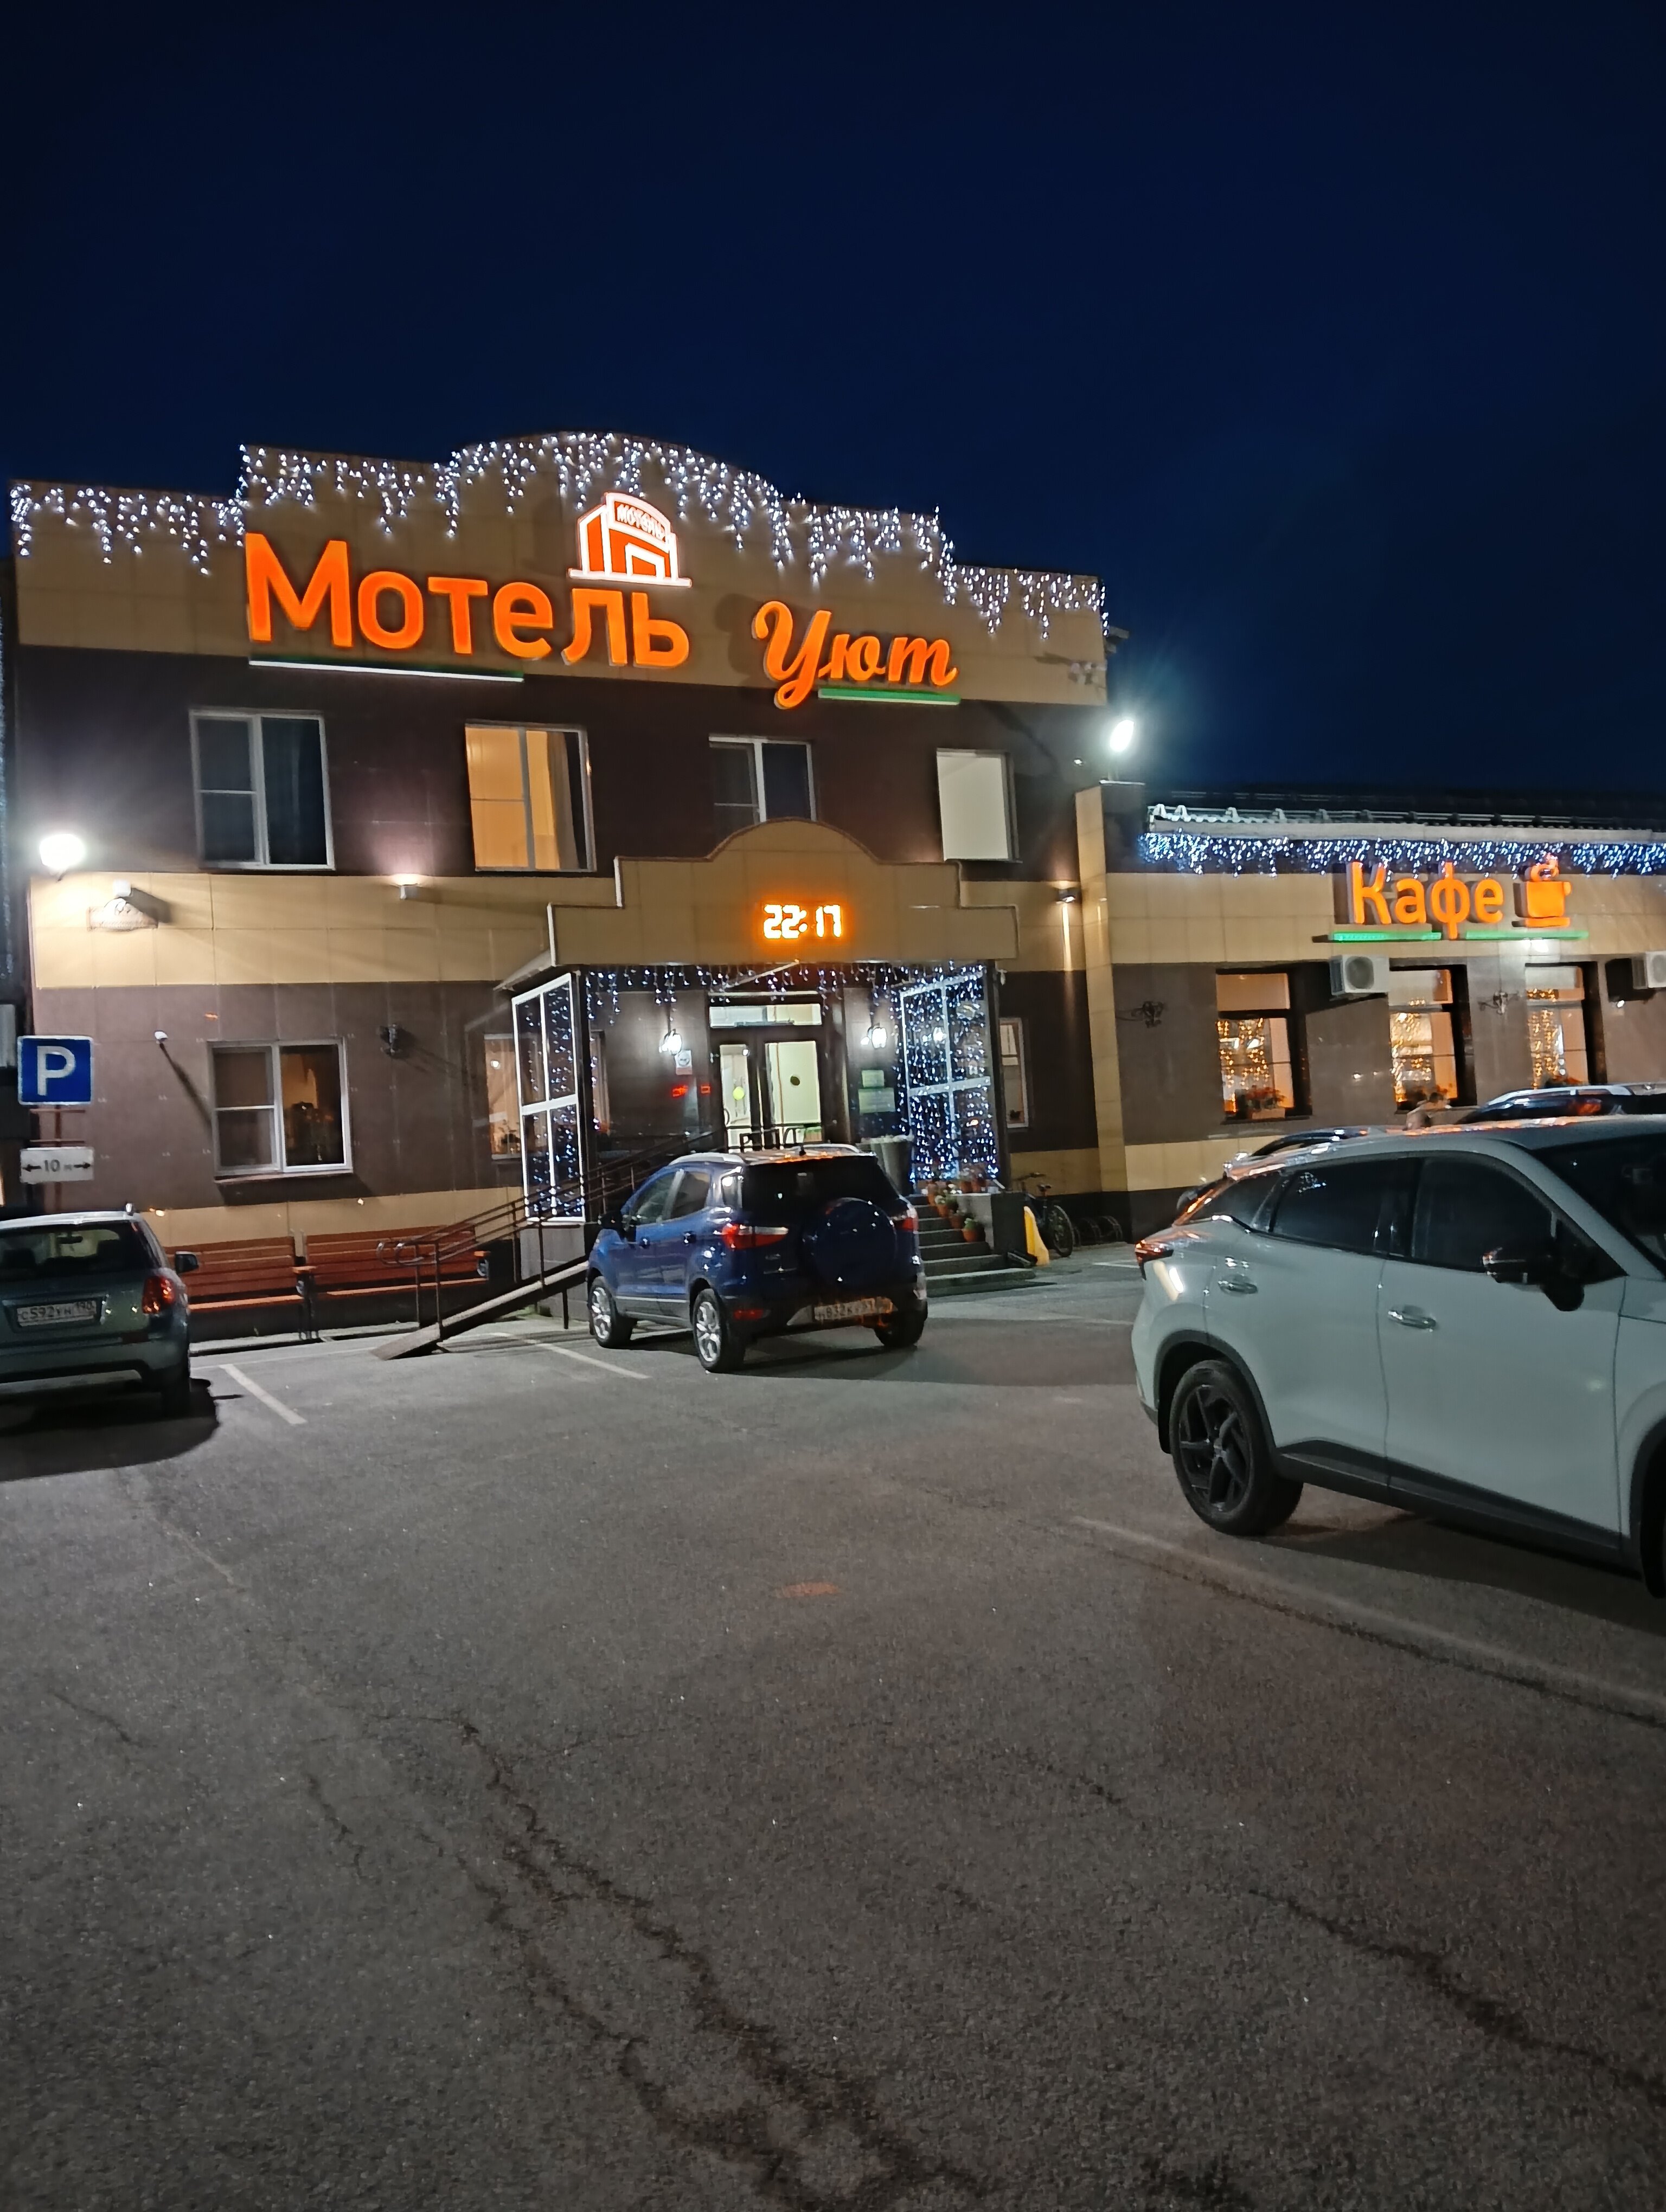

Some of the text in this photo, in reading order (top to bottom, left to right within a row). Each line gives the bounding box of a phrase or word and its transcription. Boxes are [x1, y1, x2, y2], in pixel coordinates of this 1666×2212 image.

[245, 532, 959, 708] Мотель Уют
[764, 904, 842, 938] 22:17
[1351, 861, 1504, 940] Кафе
[37, 1045, 76, 1091] P
[44, 1159, 60, 1172] 10
